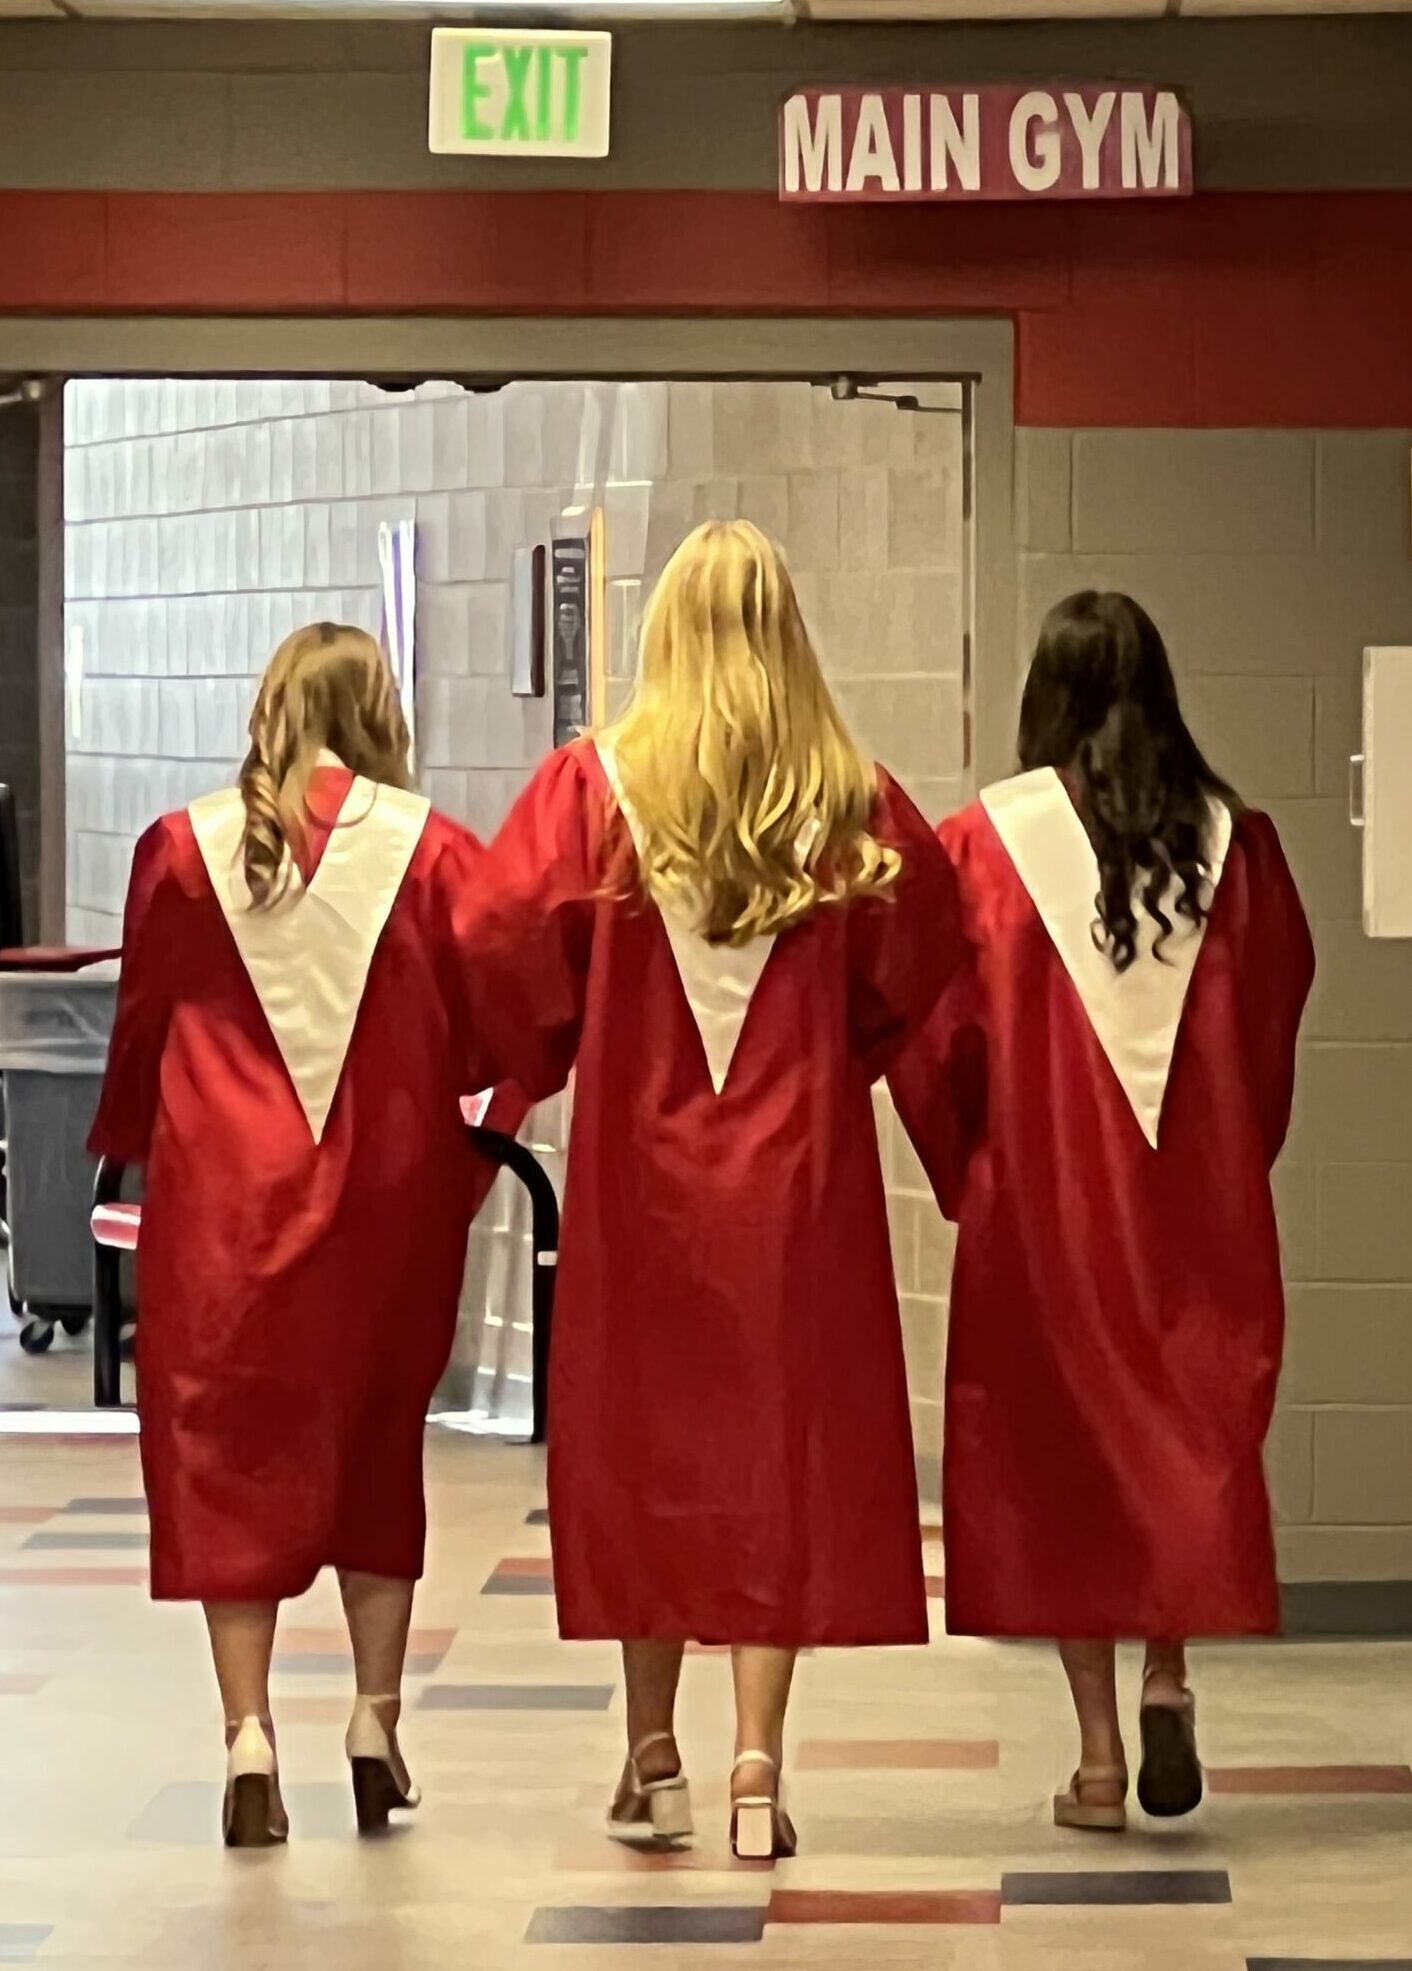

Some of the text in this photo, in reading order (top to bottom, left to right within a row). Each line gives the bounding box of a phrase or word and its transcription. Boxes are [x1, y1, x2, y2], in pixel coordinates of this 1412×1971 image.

[461, 45, 588, 141] EXIT
[783, 91, 1181, 193] MAIN GYM
